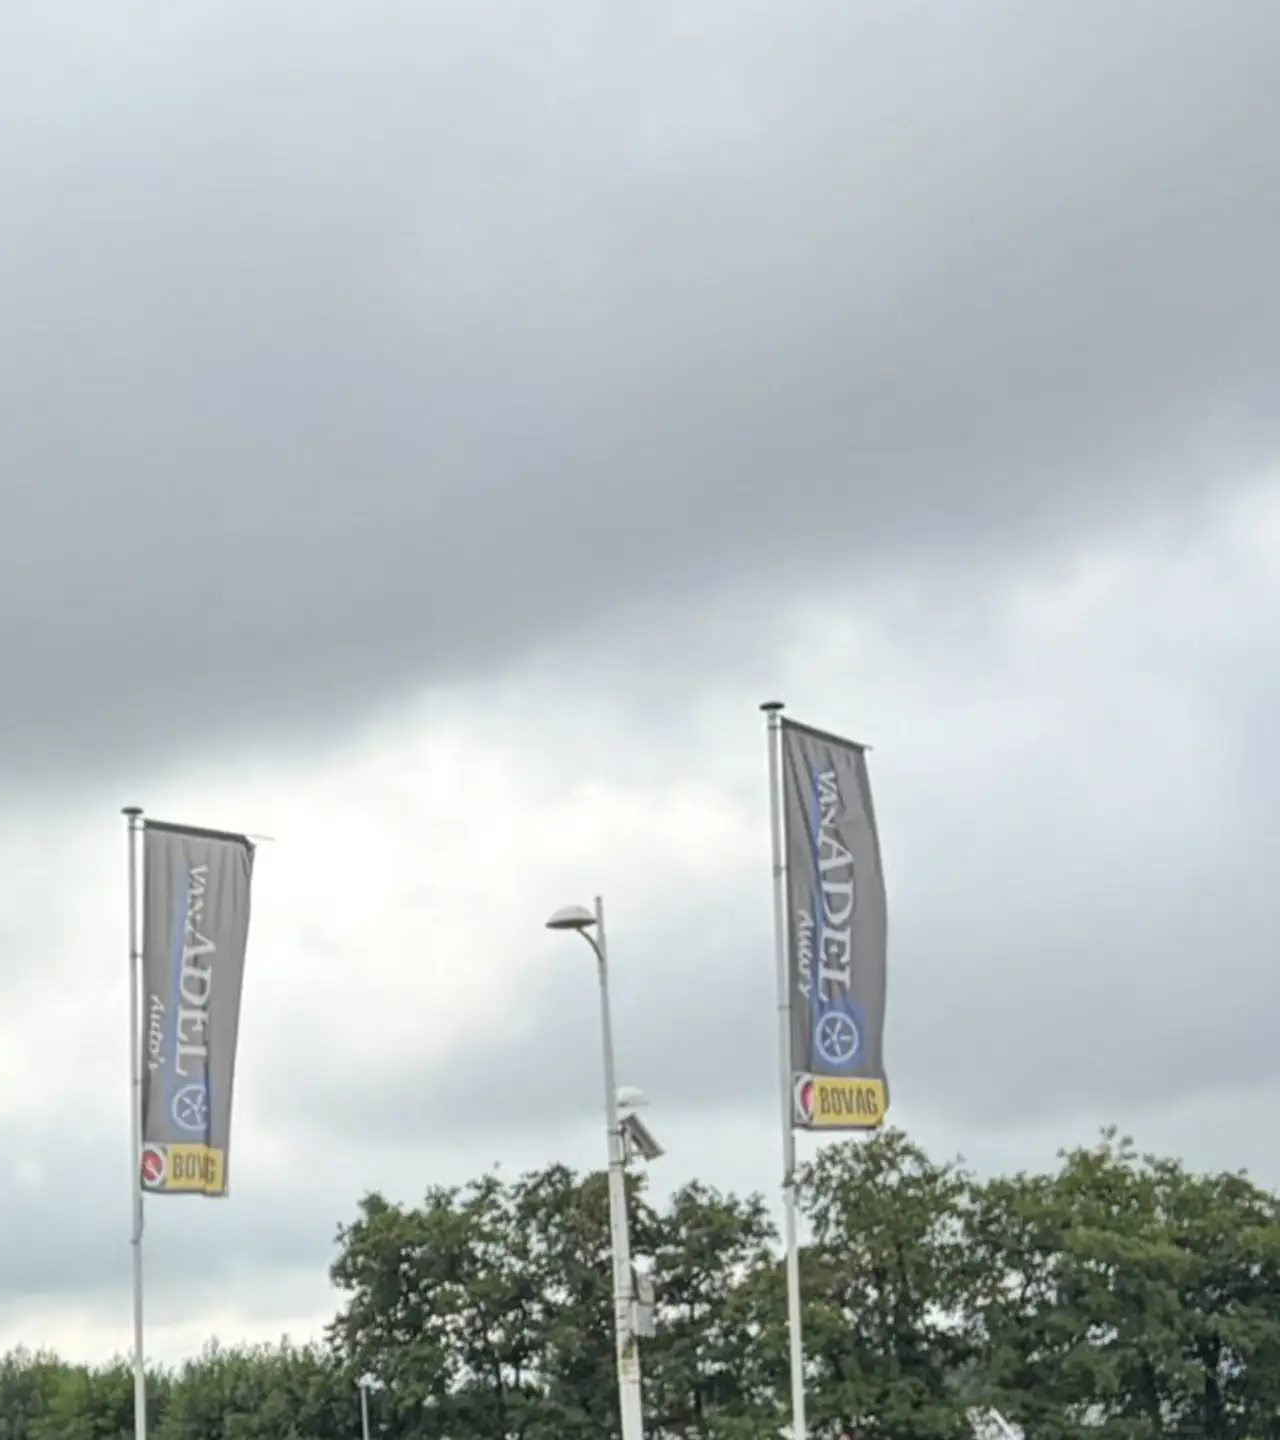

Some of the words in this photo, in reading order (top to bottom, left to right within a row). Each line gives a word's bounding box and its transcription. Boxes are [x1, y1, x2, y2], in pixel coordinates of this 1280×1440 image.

[816, 769, 839, 828] VAN
[817, 828, 856, 1003] ADEL
[175, 918, 217, 1076] ADEL
[819, 1085, 879, 1116] BOVAG
